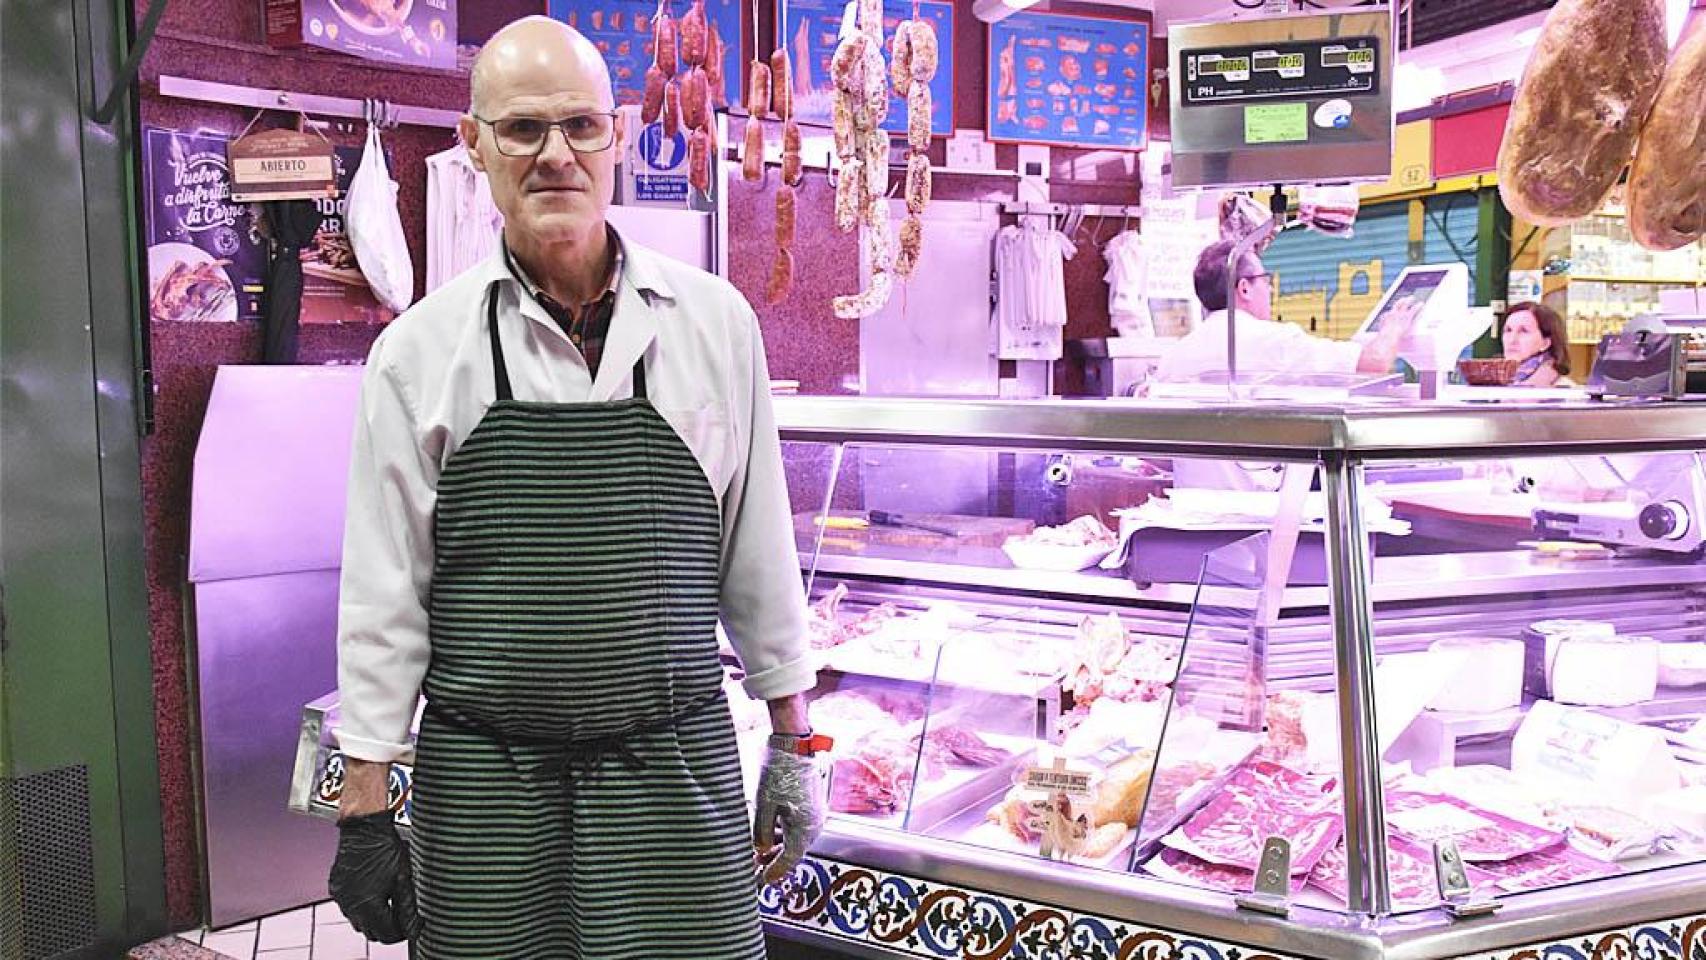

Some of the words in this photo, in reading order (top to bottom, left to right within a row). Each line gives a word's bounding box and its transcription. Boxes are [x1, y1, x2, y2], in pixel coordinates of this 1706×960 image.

[1198, 86, 1214, 97] PH
[167, 159, 224, 187] Vuelve
[260, 159, 306, 172] ABIERTO
[164, 194, 174, 206] a
[175, 181, 230, 209] disfruta
[186, 206, 201, 226] la
[202, 202, 246, 224] Carne
